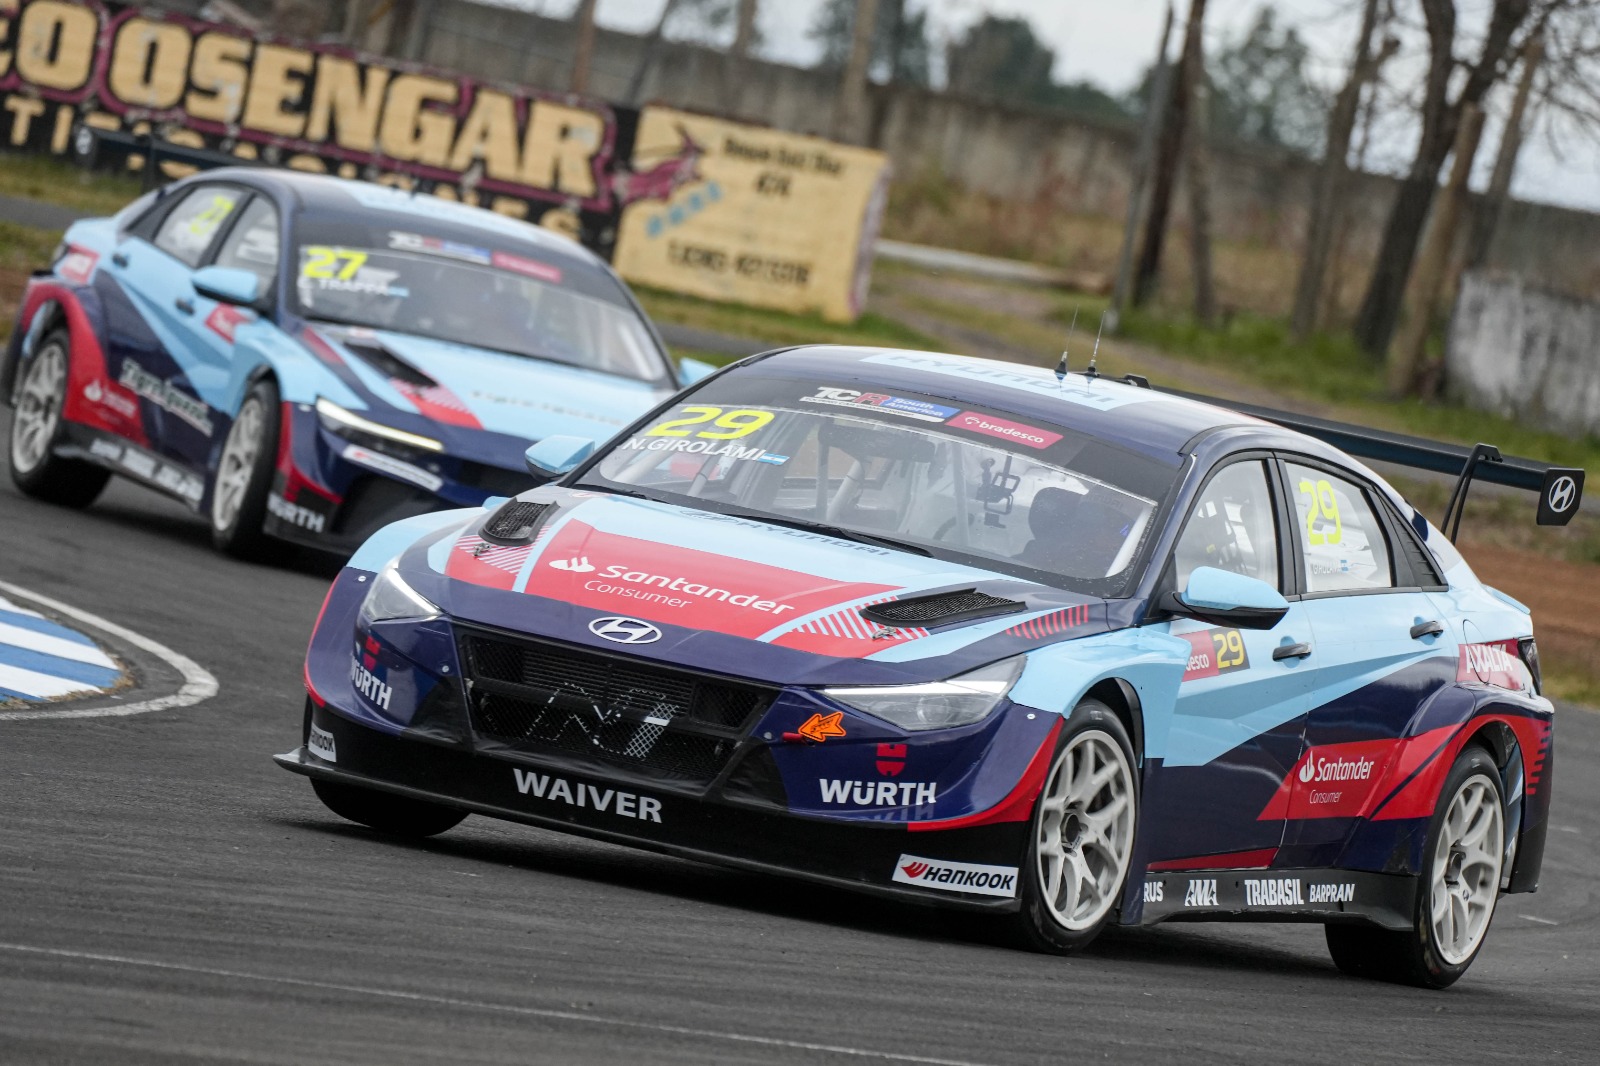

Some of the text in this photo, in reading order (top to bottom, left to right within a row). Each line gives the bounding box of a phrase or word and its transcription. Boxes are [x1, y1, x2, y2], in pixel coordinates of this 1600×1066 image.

[107, 17, 603, 198] OSENGAR
[304, 247, 368, 280] 27
[888, 354, 1116, 403] HYUNDAI
[816, 386, 892, 407] TCR
[884, 402, 944, 417] America
[893, 398, 934, 409] South
[644, 406, 775, 440] 29
[979, 421, 1044, 443] bradesco
[621, 438, 767, 461] N.GIROLAMI
[1299, 480, 1342, 545] 29
[584, 580, 693, 609] Consumer
[598, 565, 795, 615] Santander
[1213, 630, 1244, 668] 29
[1465, 643, 1513, 673] AXALTA
[1315, 756, 1374, 781] Santander
[513, 768, 663, 823] WAIVER
[819, 778, 937, 806] WÜRTH
[1310, 789, 1342, 804] Consumer
[1244, 878, 1305, 906] TRABASIL
[1309, 883, 1355, 903] BARPRAN
